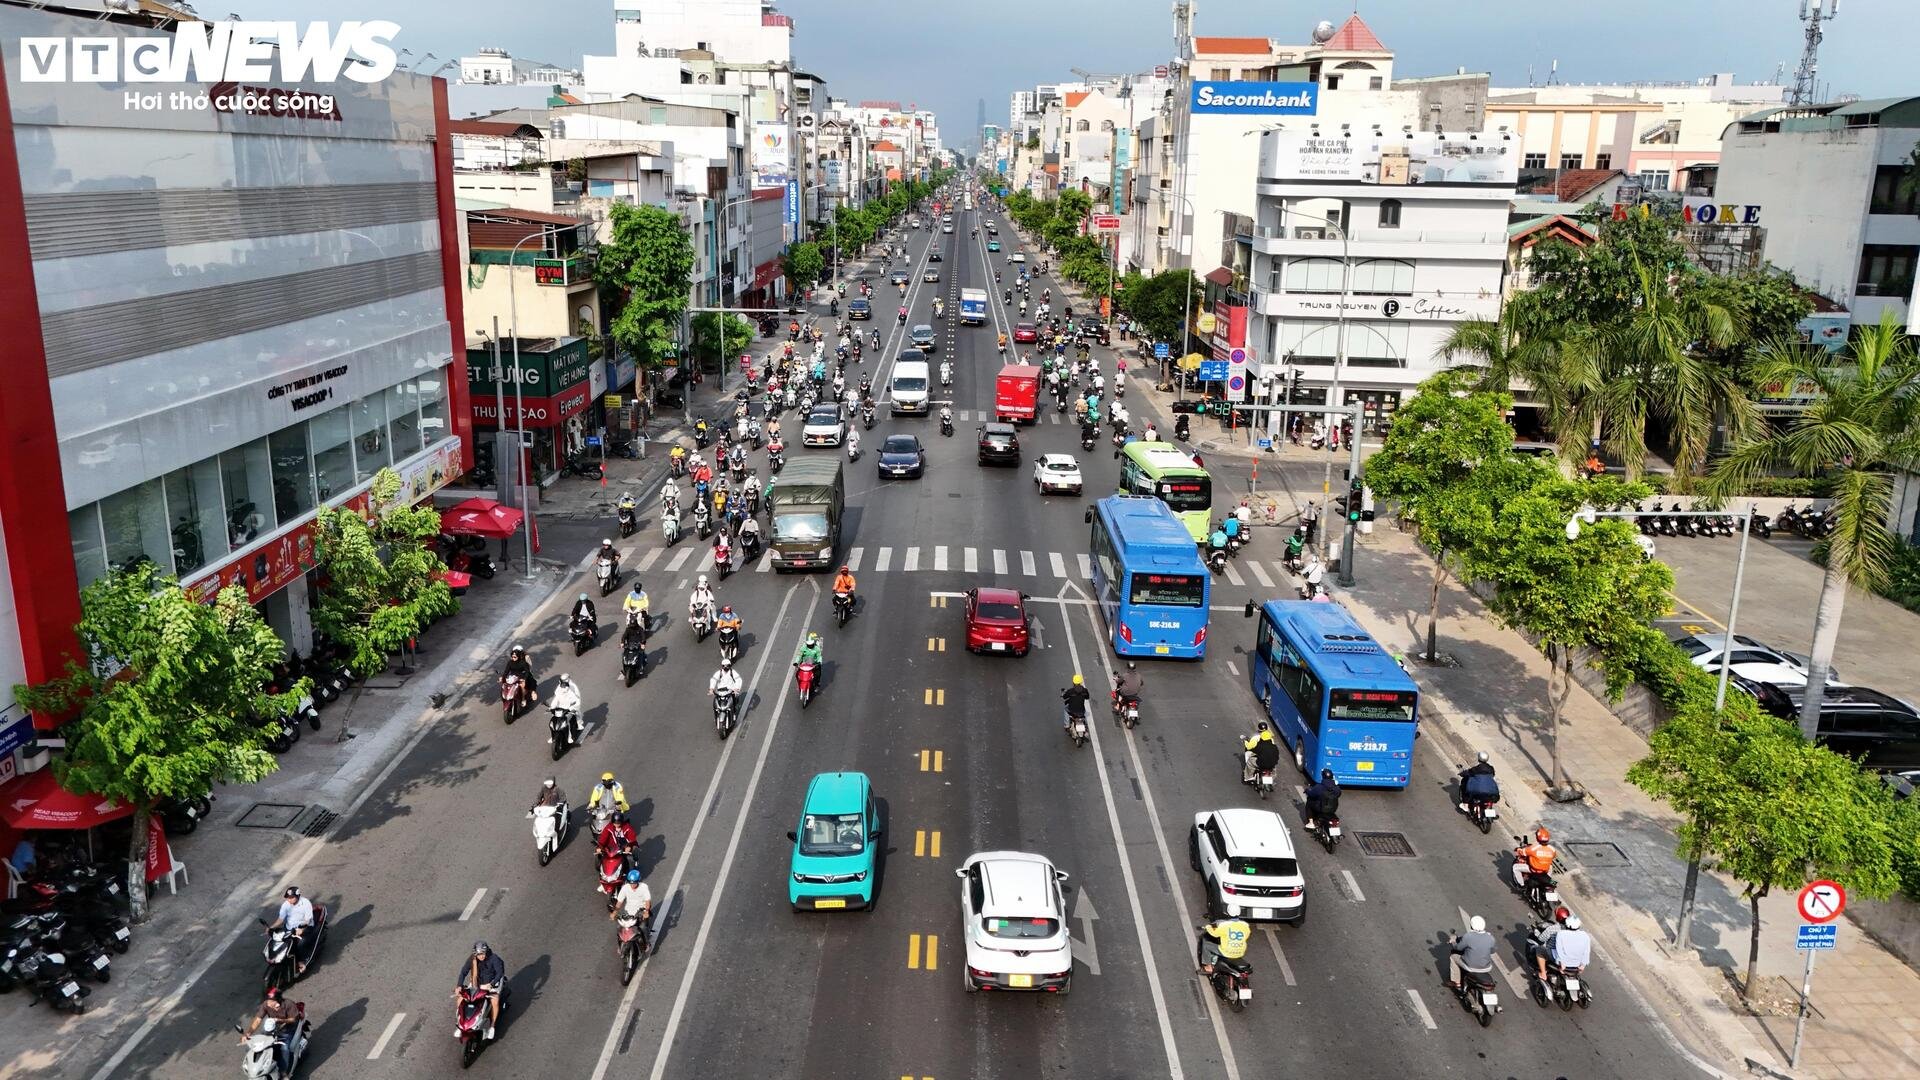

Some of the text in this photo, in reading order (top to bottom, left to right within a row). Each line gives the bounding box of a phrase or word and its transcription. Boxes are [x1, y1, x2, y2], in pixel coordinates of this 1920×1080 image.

[1197, 86, 1312, 107] Sacombank
[537, 267, 563, 278] GYM
[1414, 299, 1467, 319] Coffee
[267, 385, 285, 400] CÔNG
[284, 382, 294, 394] TY
[291, 388, 328, 412] VISACOOP
[560, 393, 585, 415] Eyewear
[149, 831, 158, 870] HONDA
[1229, 927, 1244, 941] be
